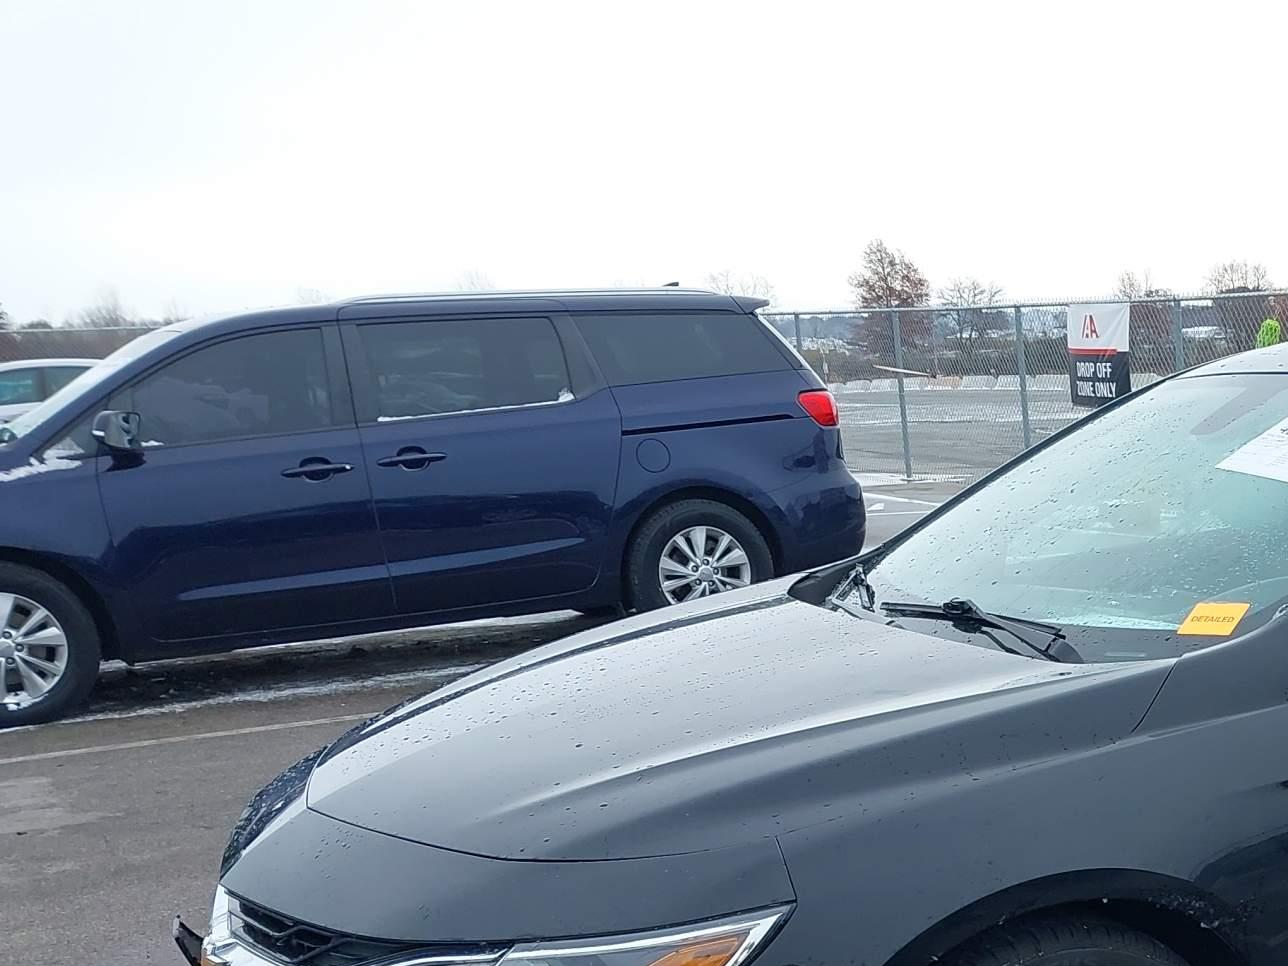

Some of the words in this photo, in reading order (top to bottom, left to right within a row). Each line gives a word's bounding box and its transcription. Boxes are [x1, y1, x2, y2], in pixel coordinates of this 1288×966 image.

[1076, 362, 1095, 378] DROP
[1096, 362, 1113, 379] OFF
[1076, 380, 1095, 397] ZONE
[1095, 381, 1117, 398] ONLY
[1191, 615, 1235, 623] DETAILED
